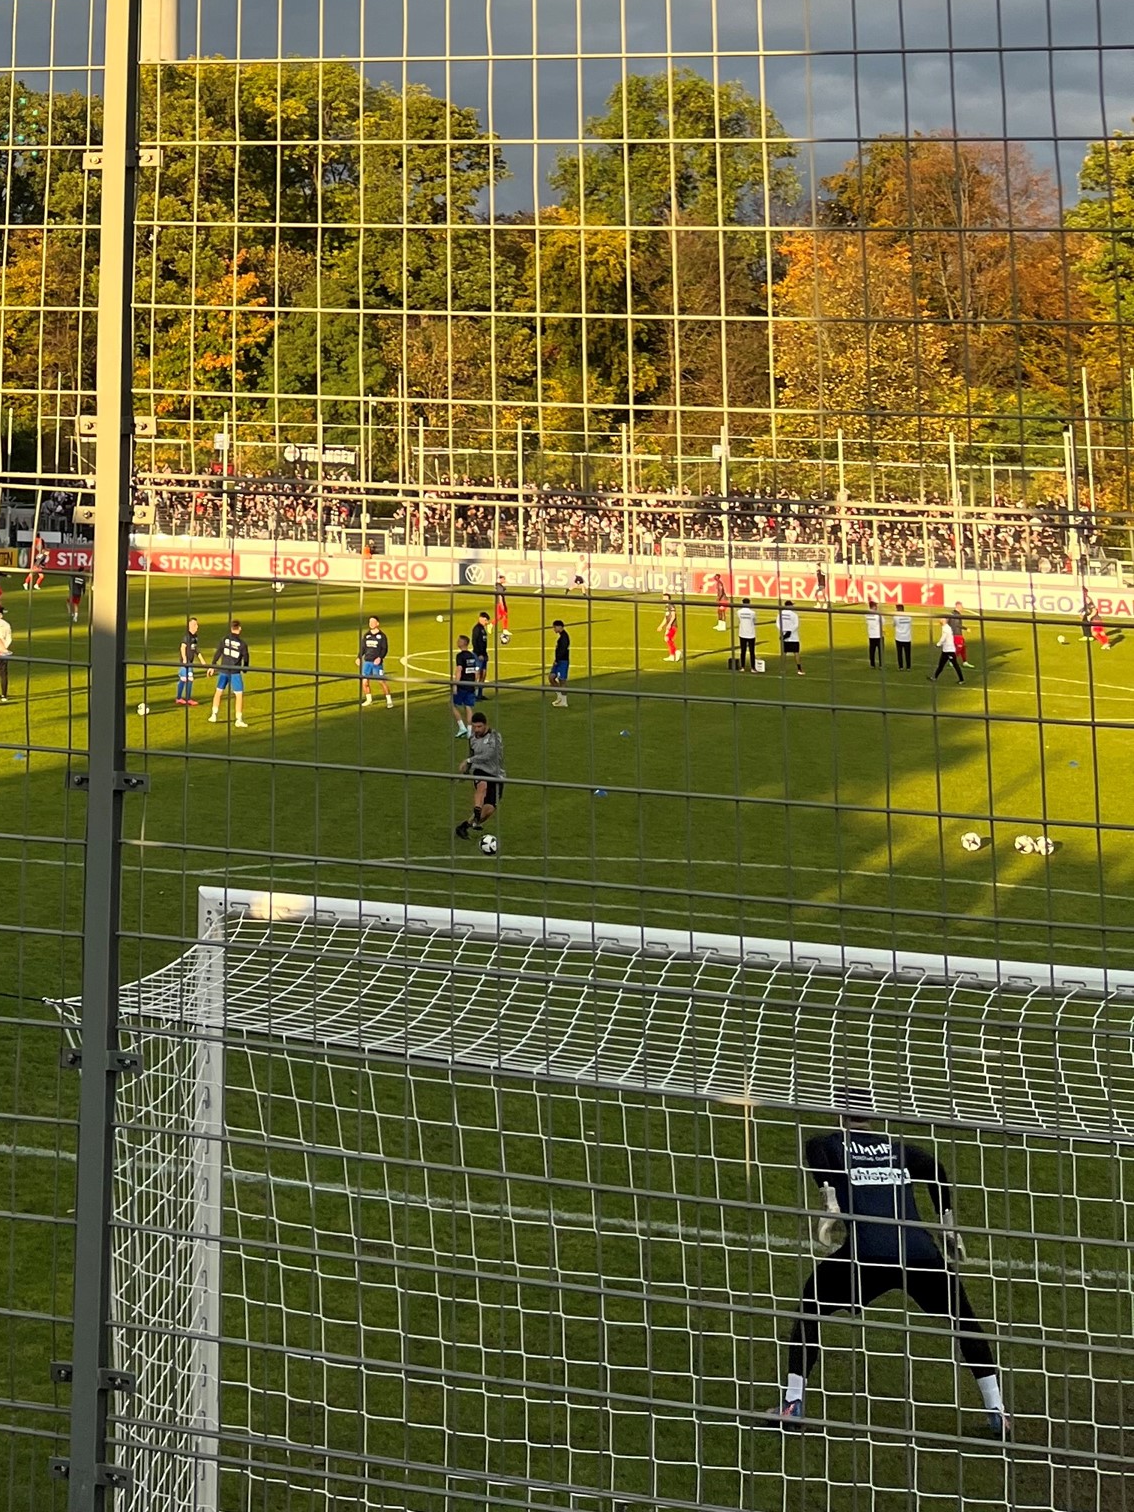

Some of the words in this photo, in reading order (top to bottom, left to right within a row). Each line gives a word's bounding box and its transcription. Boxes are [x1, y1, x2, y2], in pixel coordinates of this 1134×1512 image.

[159, 555, 233, 571] STRAUSS
[269, 556, 329, 577] ERGO
[365, 561, 428, 581] ERGO
[529, 568, 568, 586] ID.5
[609, 571, 645, 589] Der
[991, 592, 1074, 613] TARGO
